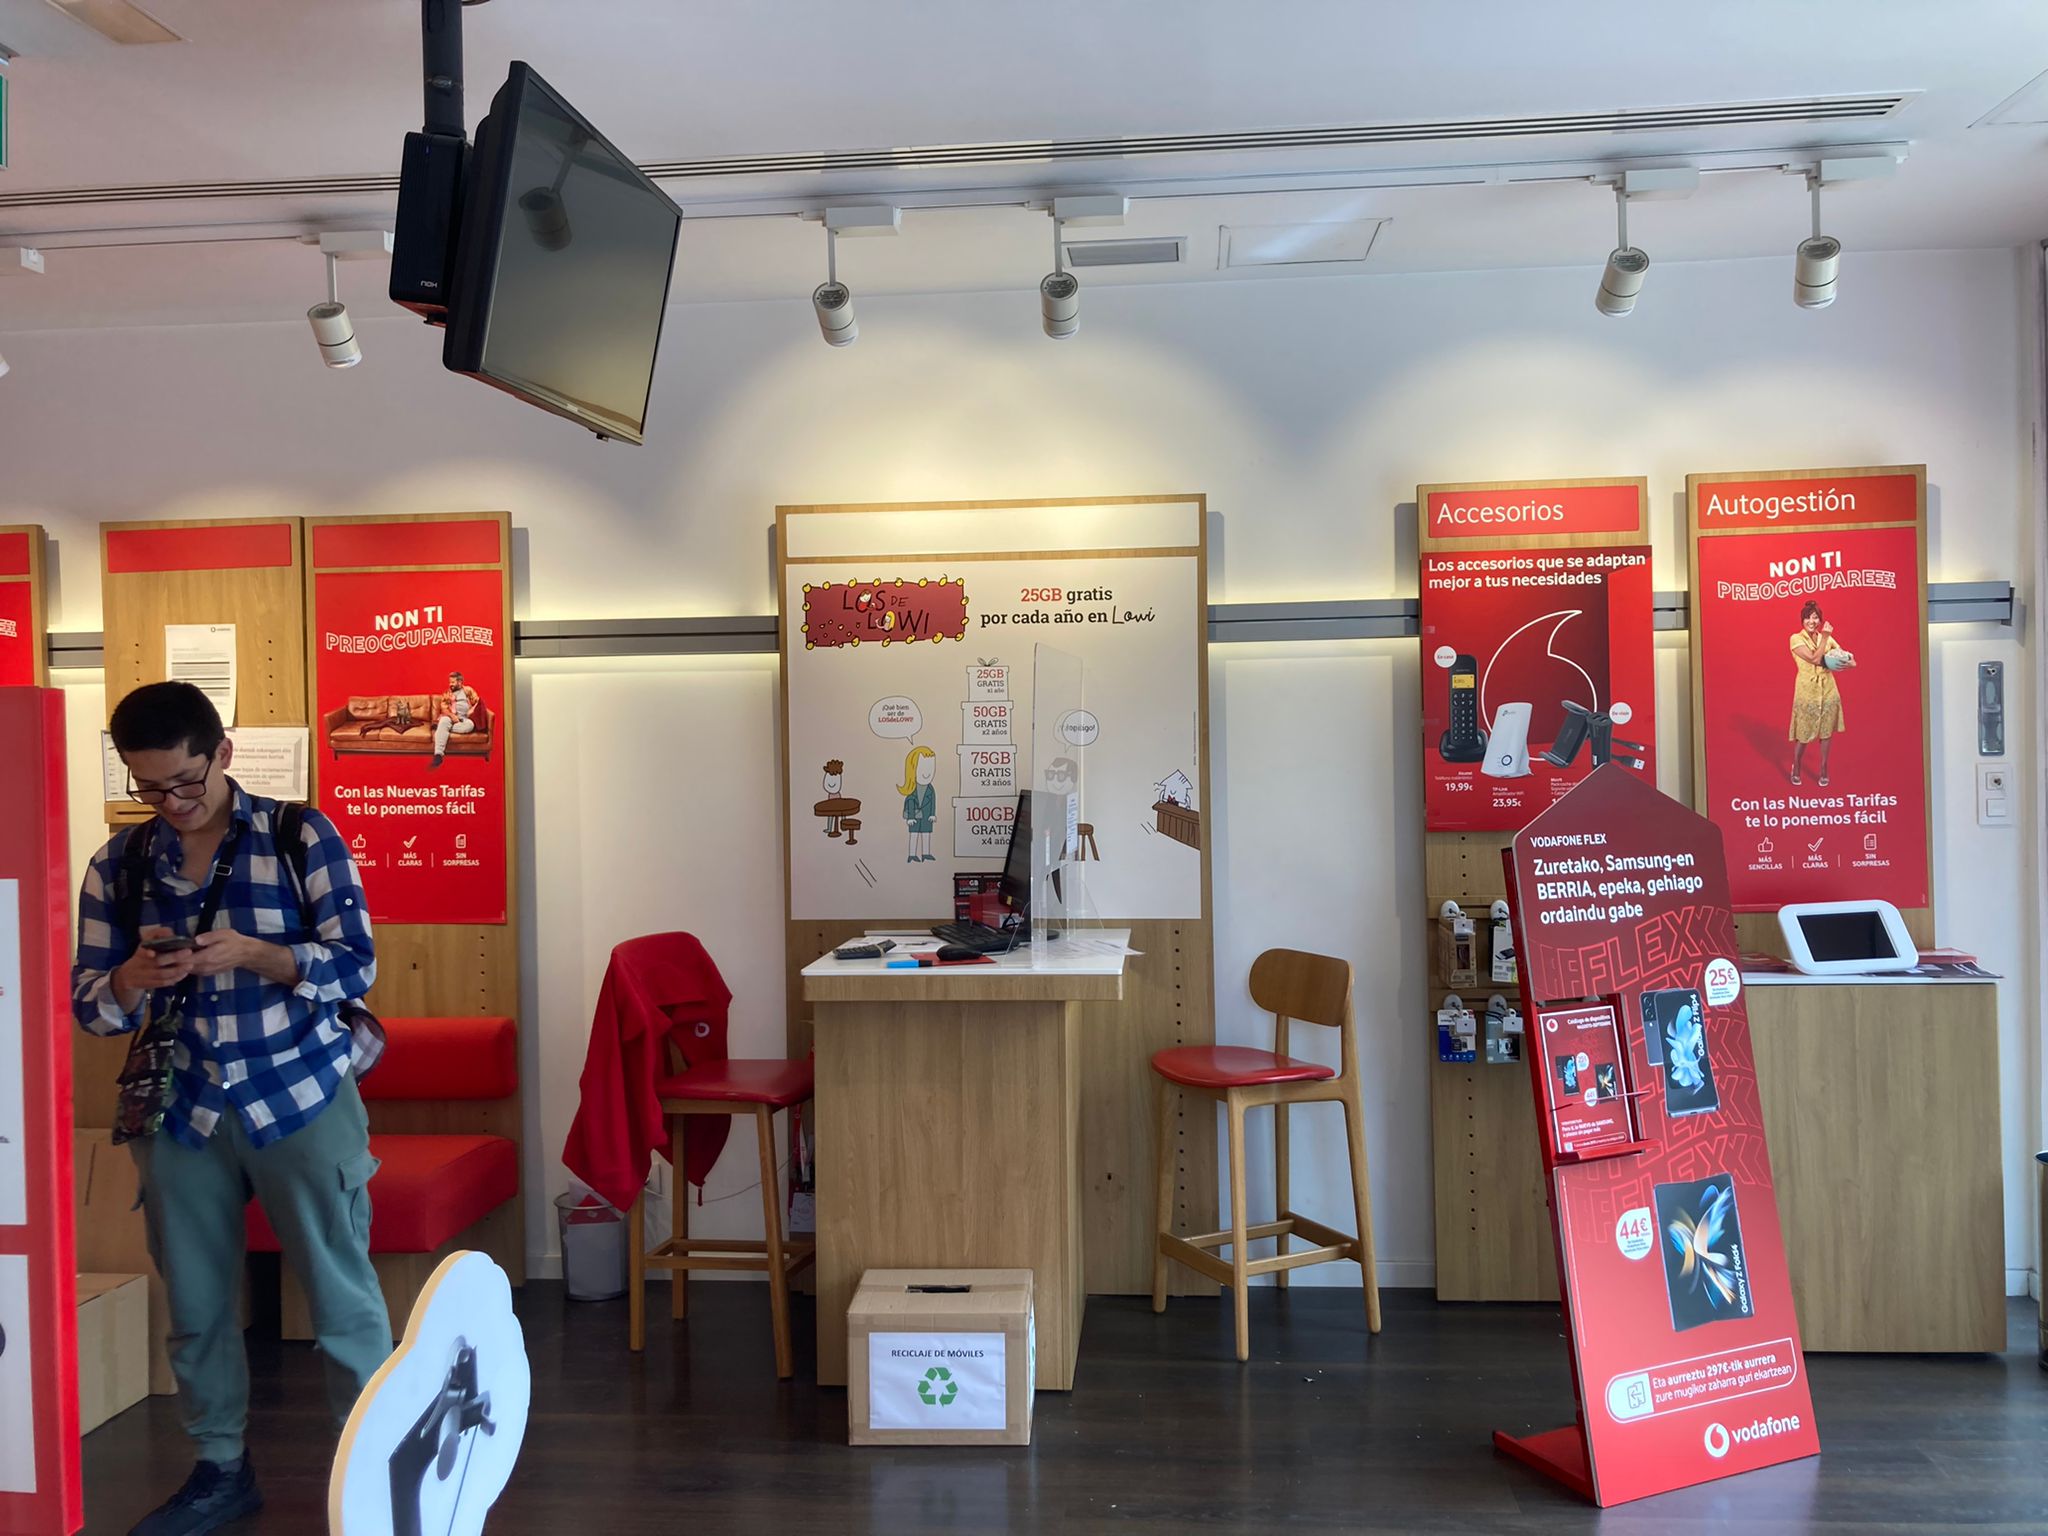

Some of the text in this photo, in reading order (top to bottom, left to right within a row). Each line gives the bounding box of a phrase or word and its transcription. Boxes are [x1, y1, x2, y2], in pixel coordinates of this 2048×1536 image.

[1706, 488, 1856, 519] Autogestión
[1436, 500, 1564, 524] Accesorios
[1428, 553, 1646, 572] Los accesorios que se adaptan
[1769, 550, 1842, 578] NON TI
[1428, 571, 1602, 592] mejor a tus necesidades
[842, 589, 910, 613] LOS DE
[1020, 586, 1113, 604] 25GB gratis
[375, 605, 443, 631] NON TI
[980, 605, 1156, 628] por cada año en Lowi
[976, 668, 1004, 679] 25GB
[976, 680, 1005, 688] GRATIS
[973, 706, 1007, 718] 50GB
[973, 720, 1008, 728] GRATIS
[970, 751, 1011, 765] 75GB
[971, 767, 1012, 777] GRATIS
[992, 778, 1012, 786] años
[1445, 782, 1473, 792] 19,99€
[334, 784, 486, 799] Con las Nuevas Tarifas
[347, 802, 476, 818] te lo ponemos fácil
[1492, 798, 1522, 808] 23,95€
[1731, 793, 1898, 812] Con las Nuevas Tarifas
[966, 807, 1015, 821] 100GB
[1745, 810, 1887, 829] te lo ponemos fácil
[971, 825, 1014, 835] GRATIS
[981, 837, 1010, 845] x4 año
[1530, 833, 1607, 848] VODAFONE FLEX
[403, 851, 417, 859] MÁS
[355, 859, 377, 867] CILLAS
[397, 859, 423, 867] CLARAS
[442, 859, 480, 867] SORPRESAS
[1533, 853, 1695, 876] Zuretako, Samsung-en
[1748, 863, 1783, 871] SENCILLAS
[1802, 861, 1829, 869] CLARAS
[1851, 860, 1890, 868] SORPRESAS
[1537, 874, 1703, 900] BERRIA, epeka, gehiago
[1540, 901, 1644, 925] ordaindu gabe
[1709, 967, 1735, 987] 25€
[1619, 1217, 1648, 1240] 44€
[1730, 1243, 1749, 1314] Galaxy Z Fold4
[891, 1347, 984, 1358] RECICLAJE DE MÓVILES
[1652, 1354, 1777, 1389] Eta aurreztu 297€-tik aurrera
[1655, 1364, 1792, 1404] zure mugikor zaharra guri ekartzean
[1731, 1414, 1801, 1445] vodafone
